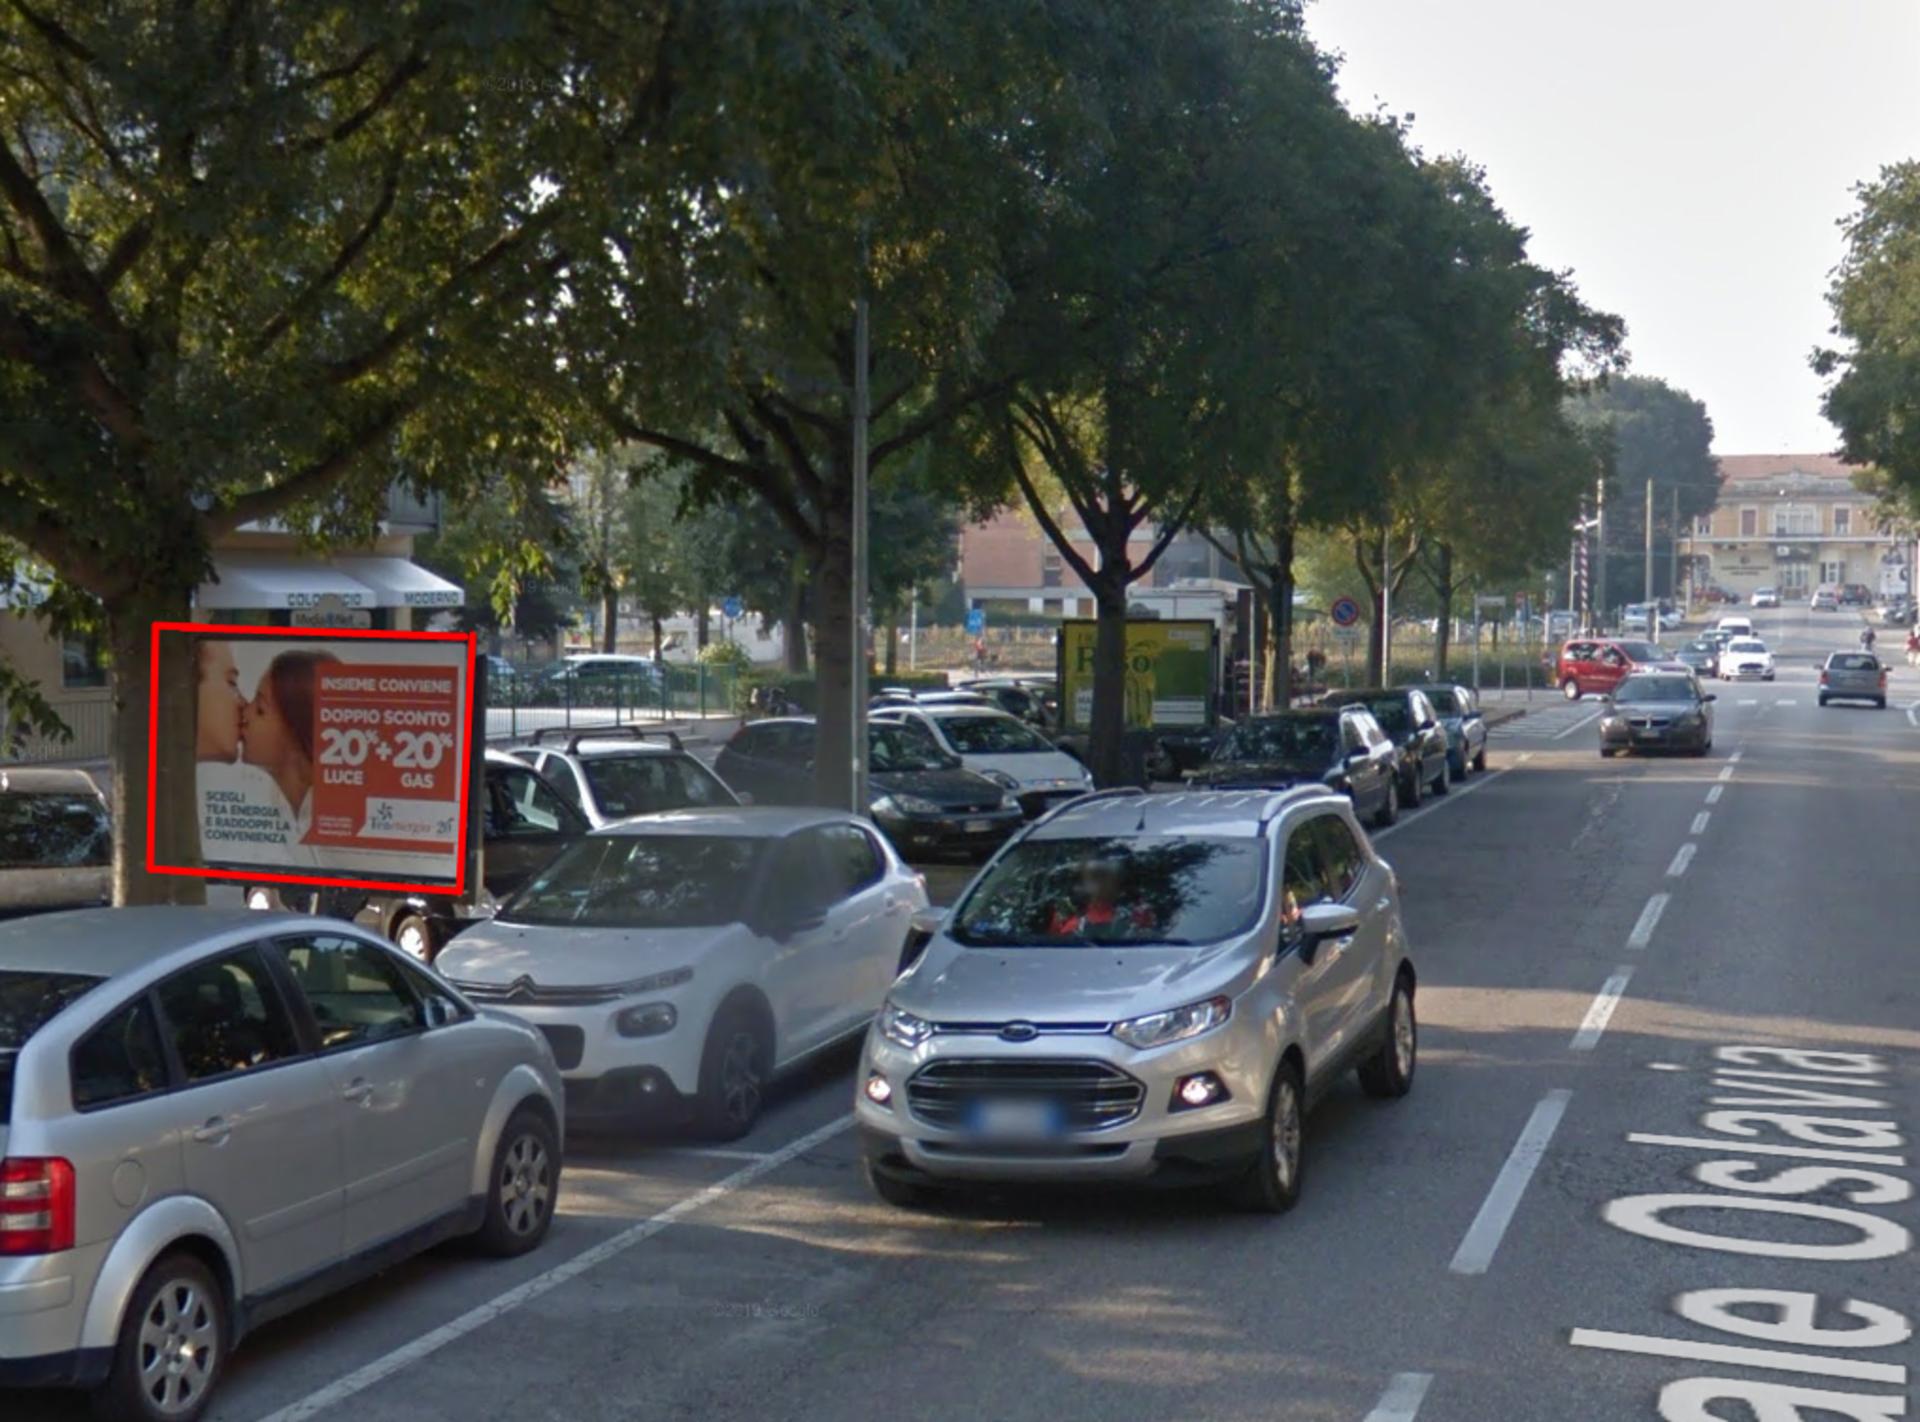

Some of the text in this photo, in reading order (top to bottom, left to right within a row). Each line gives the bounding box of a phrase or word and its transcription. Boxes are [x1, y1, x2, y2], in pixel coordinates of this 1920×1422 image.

[321, 676, 452, 694] INSIEME CONVIENE
[319, 708, 451, 727] DOPPIO SCONTO
[323, 769, 364, 785] LUCE
[401, 772, 434, 789] GAS
[205, 790, 246, 803] SCEGLI
[205, 804, 280, 817] TEA ENERGIA
[205, 816, 291, 831] E RADDOPPI LA
[204, 830, 288, 844] CONVENIENZA
[1604, 1045, 1914, 1261] Oslavia
